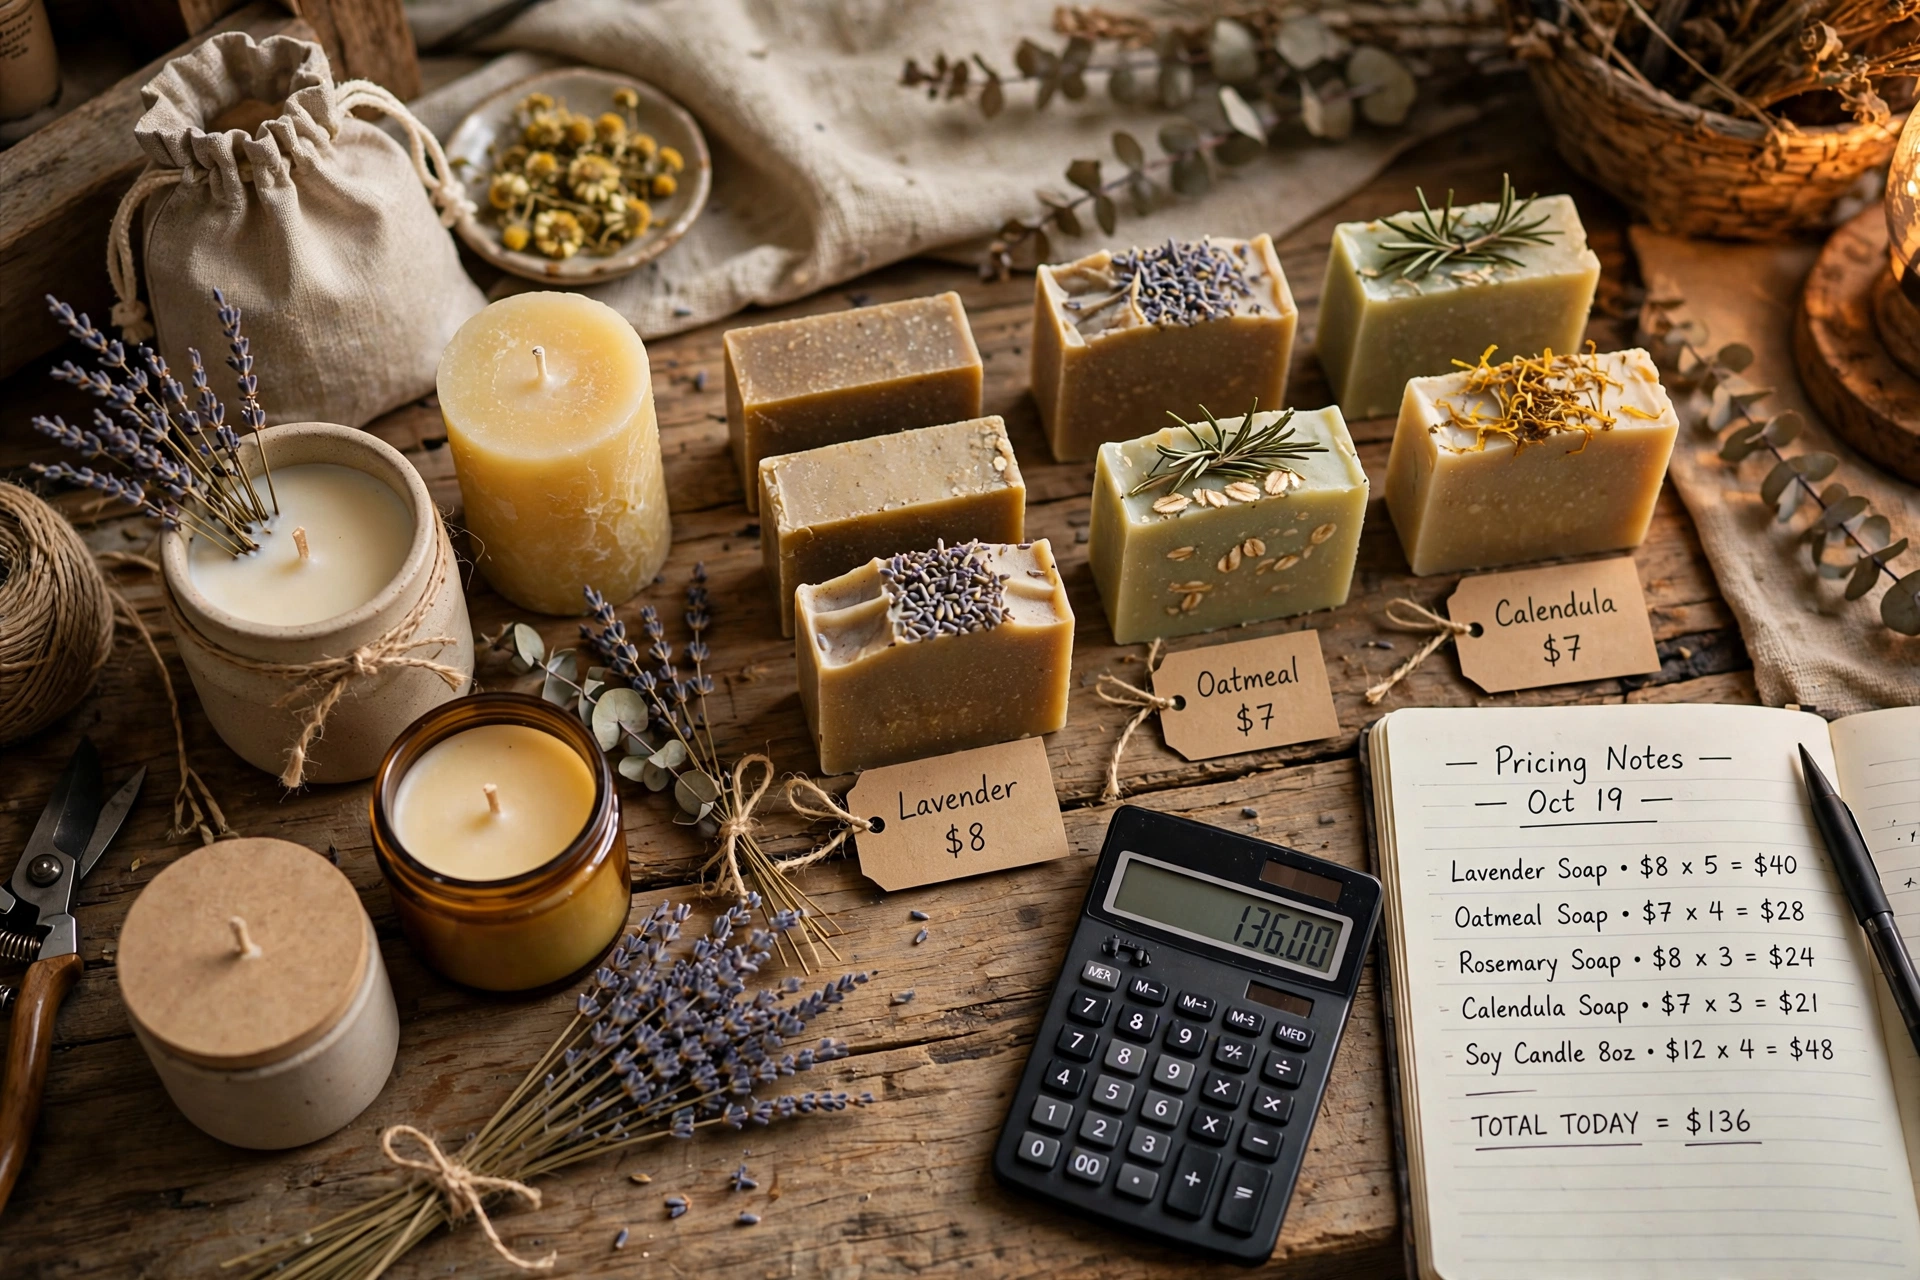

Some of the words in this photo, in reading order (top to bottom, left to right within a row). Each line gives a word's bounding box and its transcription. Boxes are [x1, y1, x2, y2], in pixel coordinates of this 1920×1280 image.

[1495, 589, 1618, 628] Calendula
[1543, 633, 1581, 668] $7
[1197, 655, 1299, 698] Oatmeal
[1236, 702, 1275, 737] $7
[1495, 744, 1587, 785] Pricing
[1606, 743, 1684, 771] Notes
[898, 773, 1018, 826] Lavender
[1527, 788, 1575, 815] Oct
[1597, 786, 1623, 812] 19
[945, 821, 986, 859] $8
[1451, 857, 1546, 883] Lavender
[1557, 857, 1608, 886] Soap
[1640, 853, 1669, 880] $8
[1704, 854, 1718, 875] 5
[1754, 852, 1798, 878] $40
[1454, 903, 1542, 929] Oatmeal
[1557, 903, 1608, 933] Soap
[1642, 899, 1672, 926] $7
[1708, 900, 1724, 922] 4
[1760, 897, 1805, 924] $28
[1233, 905, 1334, 969] 136.00
[1459, 949, 1558, 982] Rosemary
[1571, 948, 1622, 978] Soap
[1652, 945, 1682, 972] $8
[1718, 945, 1733, 968] 3
[1768, 943, 1815, 970] $24
[1082, 997, 1097, 1013] 7
[1129, 1013, 1144, 1030] 8
[1179, 1028, 1192, 1044] 9
[1461, 994, 1566, 1020] Calendula
[1578, 994, 1629, 1023] Soap
[1661, 990, 1691, 1017] $7
[1727, 991, 1743, 1013] 3
[1778, 989, 1818, 1016] $21
[1070, 1032, 1085, 1049] 7
[1117, 1047, 1132, 1065] 8
[1167, 1063, 1181, 1079] 9
[1465, 1042, 1503, 1076] Soy
[1514, 1039, 1586, 1065] Candle
[1598, 1040, 1636, 1063] 8oz
[1665, 1036, 1706, 1064] $12
[1739, 1038, 1755, 1060] 4
[1789, 1035, 1834, 1062] $48
[1056, 1068, 1070, 1086] 4
[1105, 1083, 1120, 1100] 5
[1155, 1100, 1168, 1116] 6
[1048, 1104, 1056, 1121] 1
[1092, 1119, 1107, 1138] 2
[1141, 1135, 1156, 1153] 3
[1470, 1113, 1548, 1138] TOTAL
[1559, 1110, 1639, 1135] TODAY
[1686, 1106, 1751, 1137] $136
[1031, 1140, 1045, 1157] 0
[1075, 1154, 1100, 1175] 00
